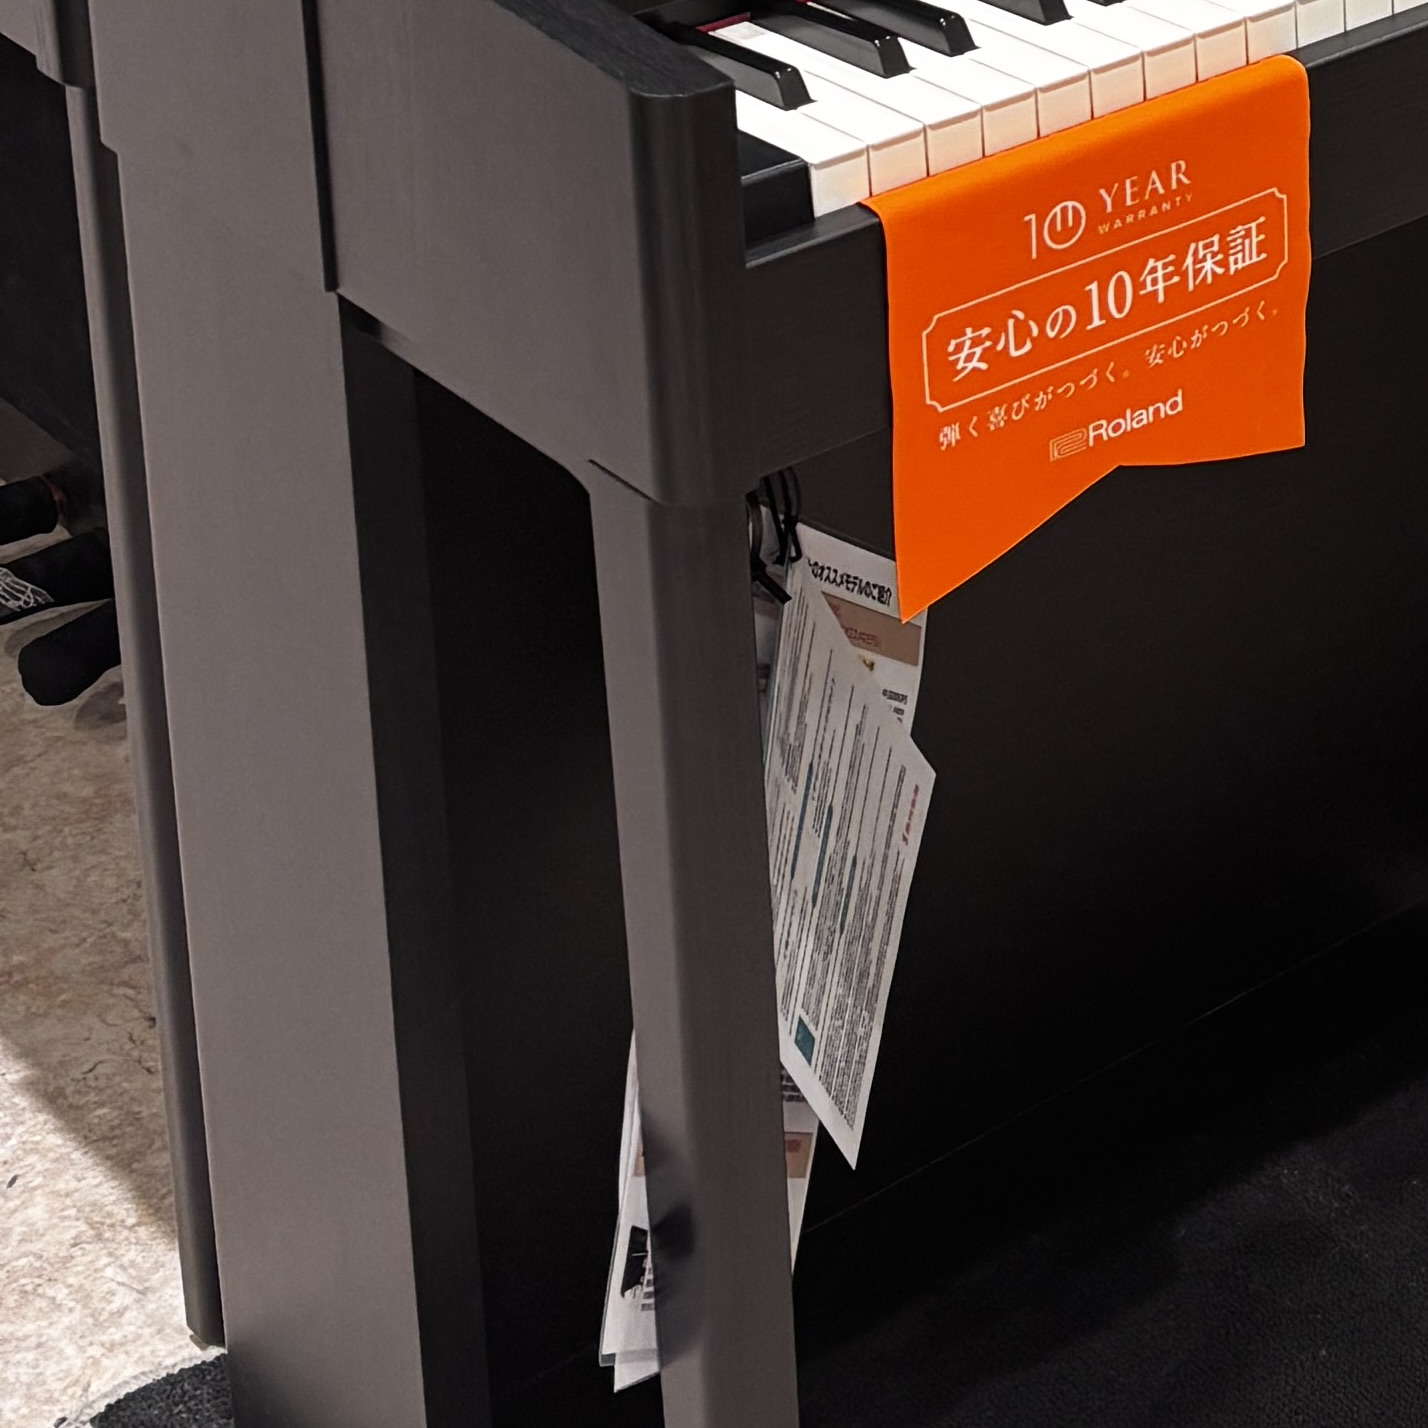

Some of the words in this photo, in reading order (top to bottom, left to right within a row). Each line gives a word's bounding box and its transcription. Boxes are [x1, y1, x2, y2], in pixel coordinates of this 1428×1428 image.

[1022, 199, 1087, 260] 10
[1097, 158, 1192, 216] YEAR
[1096, 192, 1195, 235] WARRANTY
[945, 215, 1268, 383] 安心の10年保証
[938, 359, 1131, 451] 弾く喜びがつづく。
[1143, 301, 1279, 369] 安心がつづく。
[1087, 389, 1185, 448] Roland
